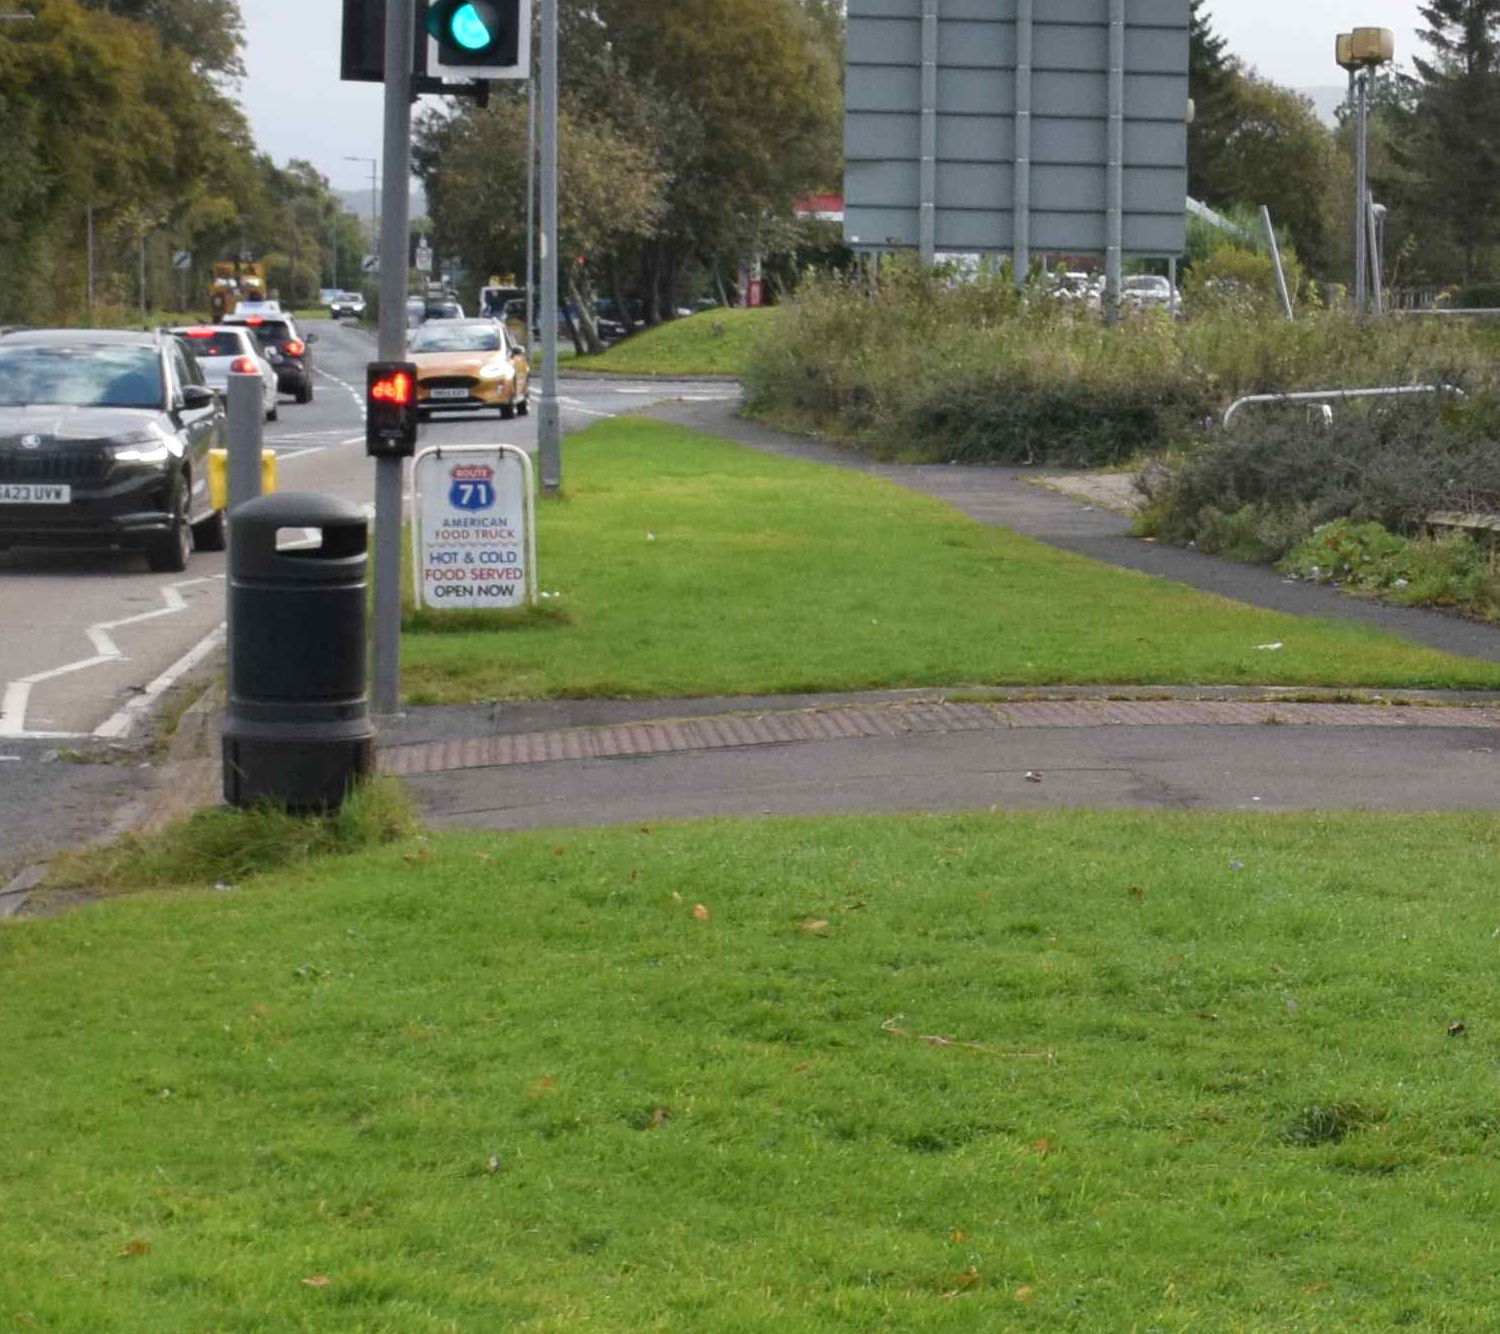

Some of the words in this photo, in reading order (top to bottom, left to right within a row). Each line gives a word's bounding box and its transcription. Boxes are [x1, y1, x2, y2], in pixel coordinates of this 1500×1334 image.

[456, 469, 488, 478] ROUTE
[459, 484, 488, 504] 71
[443, 517, 508, 528] AMERICAN
[435, 529, 470, 540] FOOD
[475, 529, 515, 540] TRUCK
[429, 552, 459, 565] HOT
[463, 552, 475, 564] &
[479, 551, 517, 564] COLD
[425, 568, 466, 581] FOOD
[469, 568, 523, 581] SERVED
[434, 585, 474, 598] OPEN
[477, 584, 515, 597] NOW
